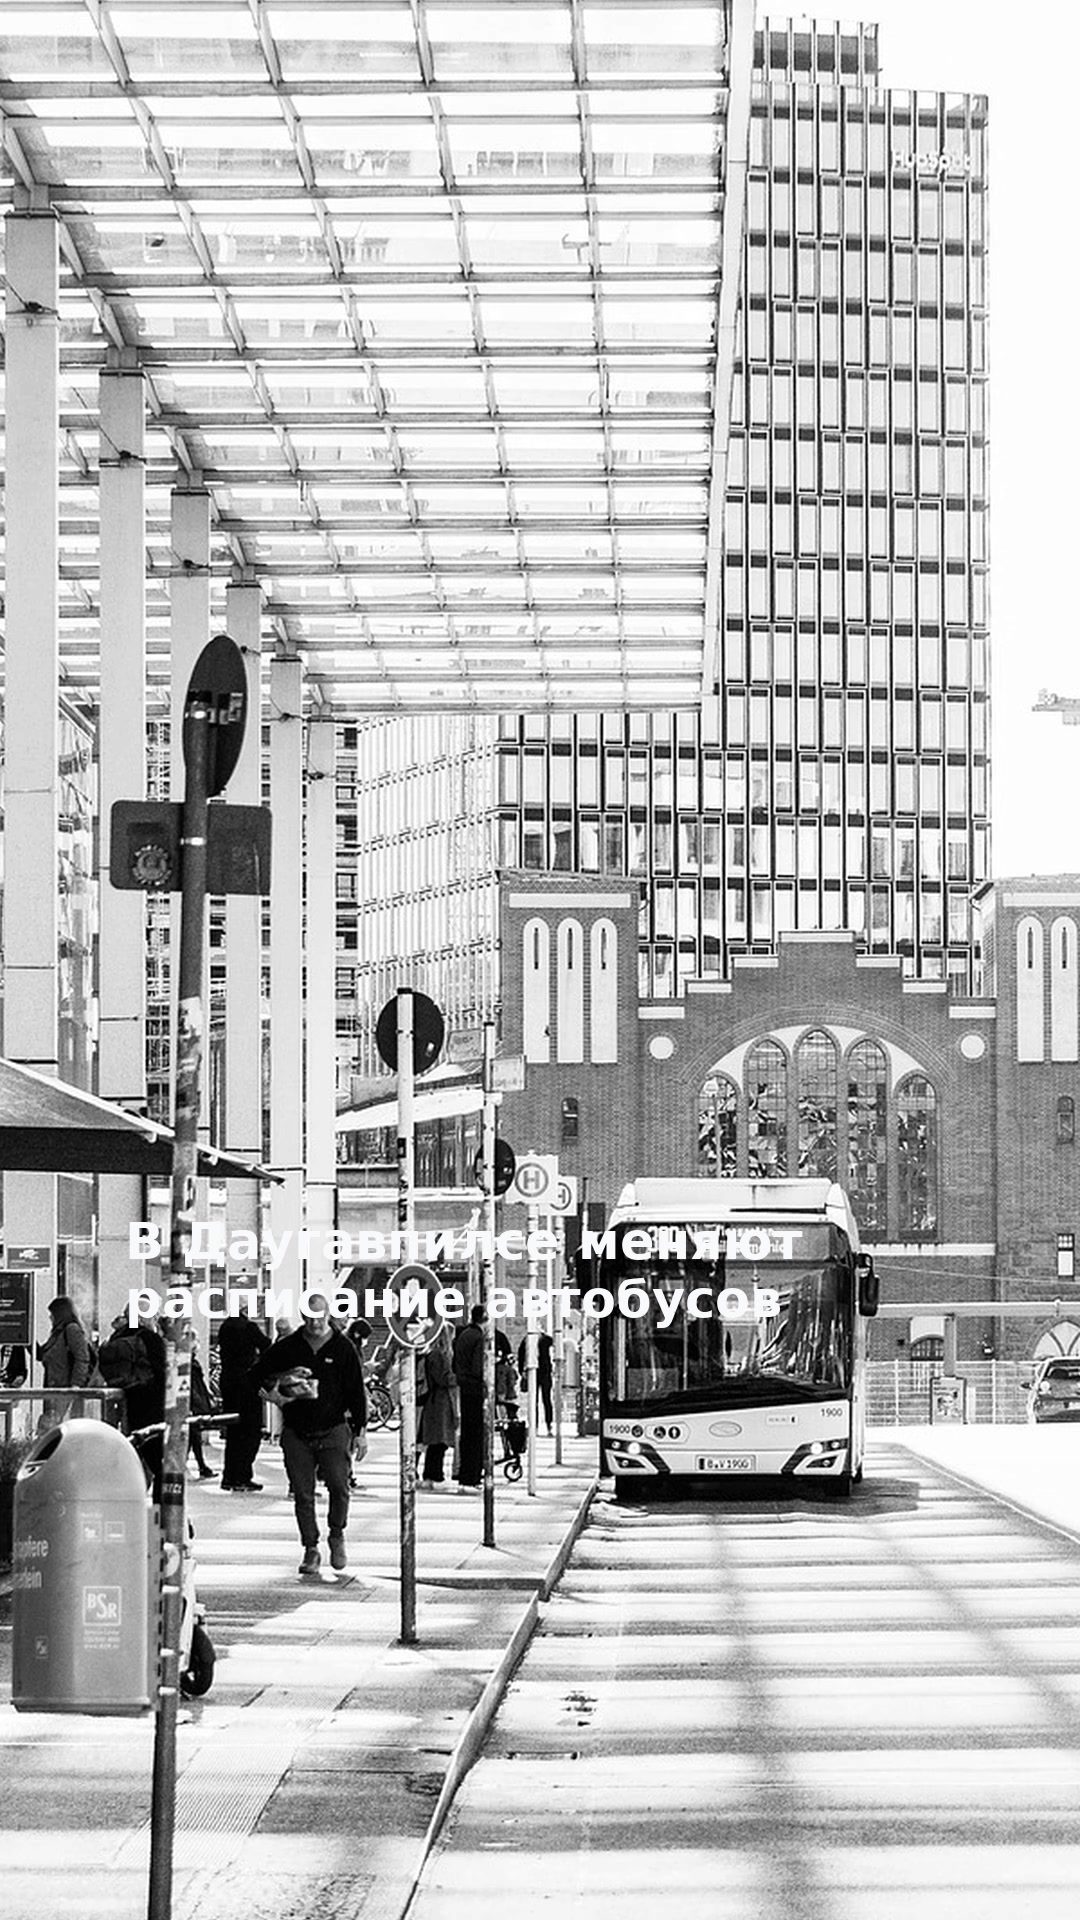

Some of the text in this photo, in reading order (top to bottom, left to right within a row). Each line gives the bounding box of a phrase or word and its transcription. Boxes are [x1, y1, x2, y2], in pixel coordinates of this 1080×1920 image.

[821, 1407, 843, 1417] 1900
[609, 1424, 631, 1434] 1900
[87, 1592, 118, 1619] BSR
